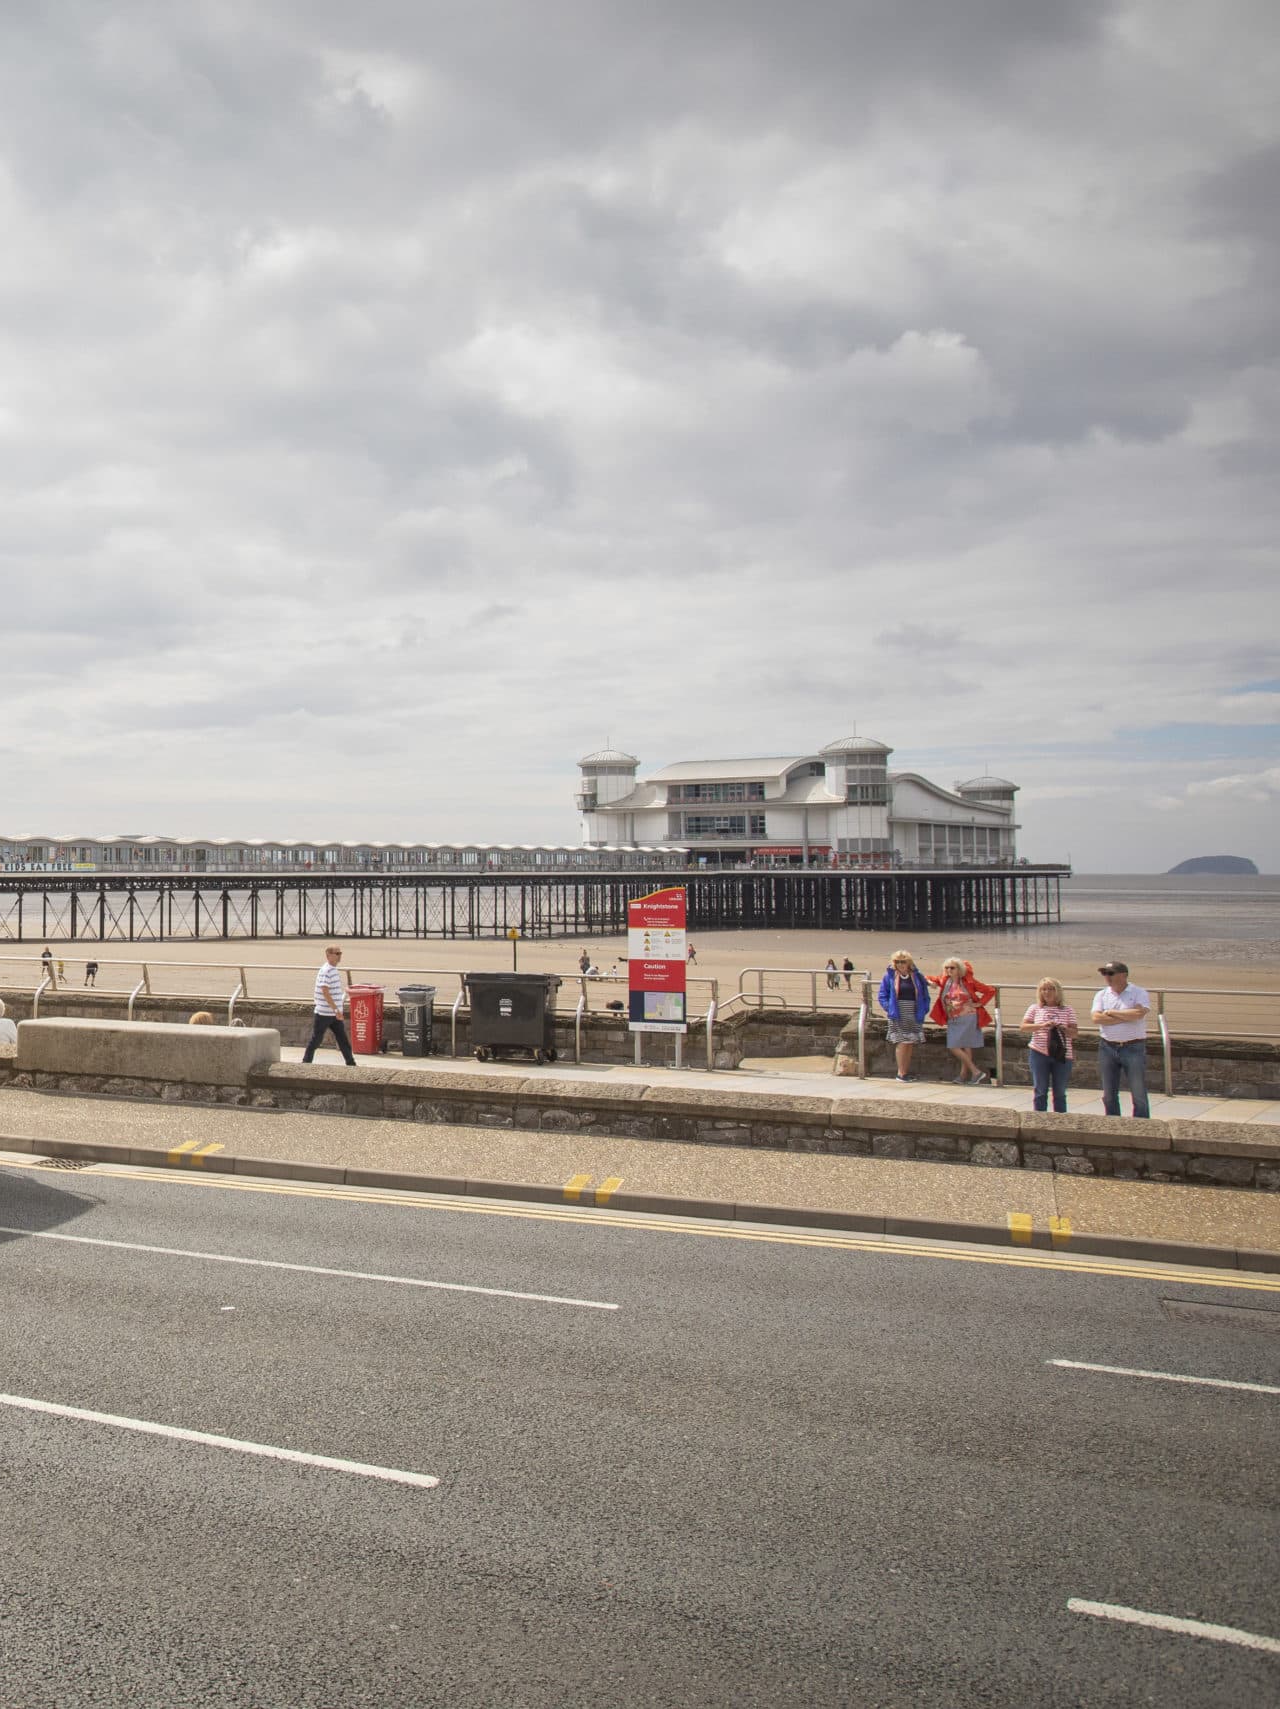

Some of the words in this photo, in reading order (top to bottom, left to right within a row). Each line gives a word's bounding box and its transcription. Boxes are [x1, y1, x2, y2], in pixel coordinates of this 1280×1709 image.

[4, 863, 26, 871] KIDS
[30, 863, 47, 871] EAT
[51, 863, 72, 871] FREE
